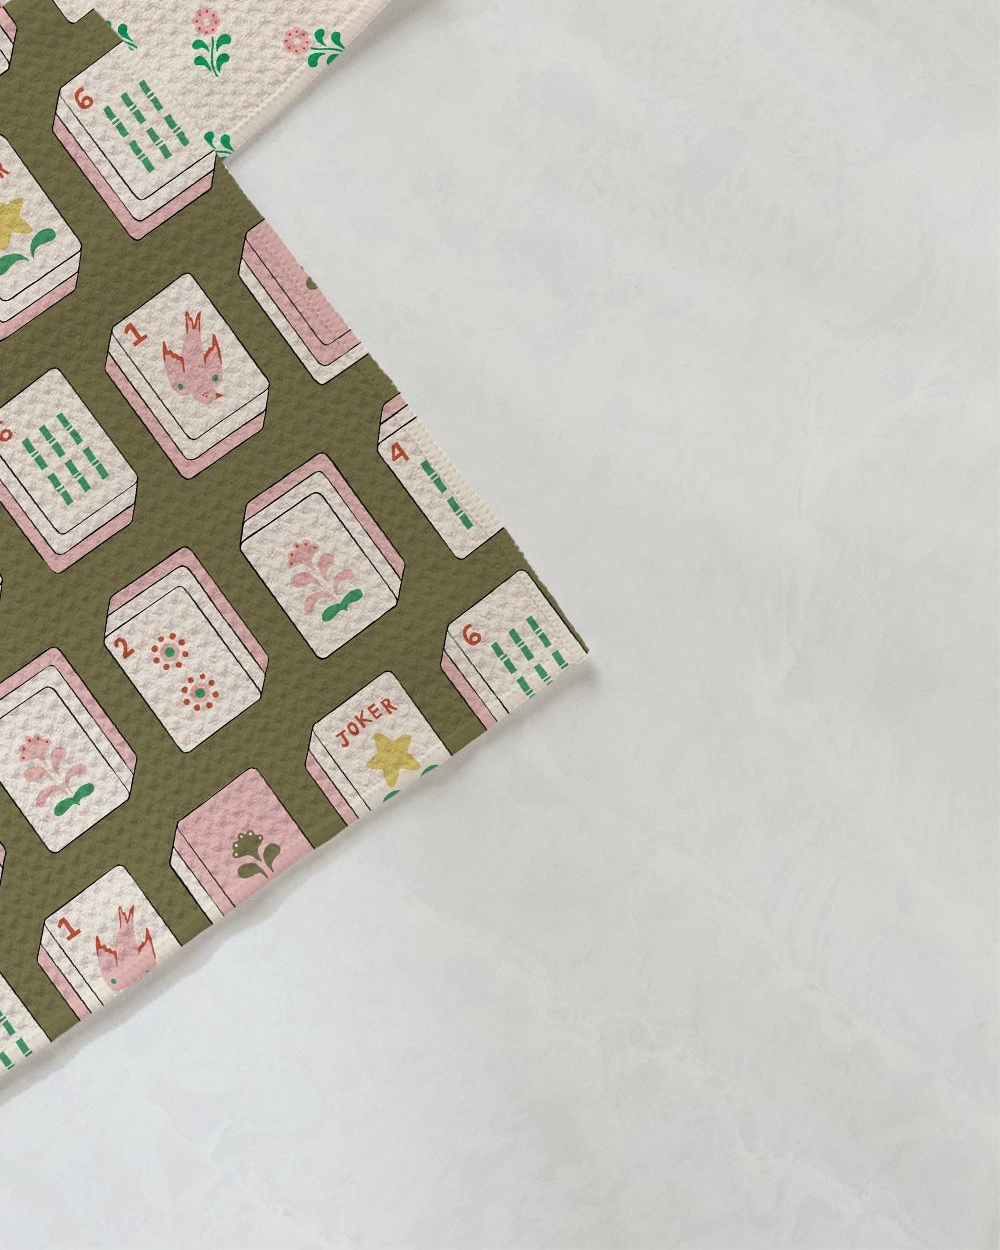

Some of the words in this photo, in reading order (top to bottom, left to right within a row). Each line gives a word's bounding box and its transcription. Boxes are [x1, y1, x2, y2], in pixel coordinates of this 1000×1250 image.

[73, 86, 95, 110] 6
[123, 322, 148, 347] 1
[391, 441, 410, 462] 4
[461, 623, 482, 647] 6
[113, 637, 135, 659] 2
[336, 698, 397, 748] JOKER
[57, 917, 82, 941] 1
